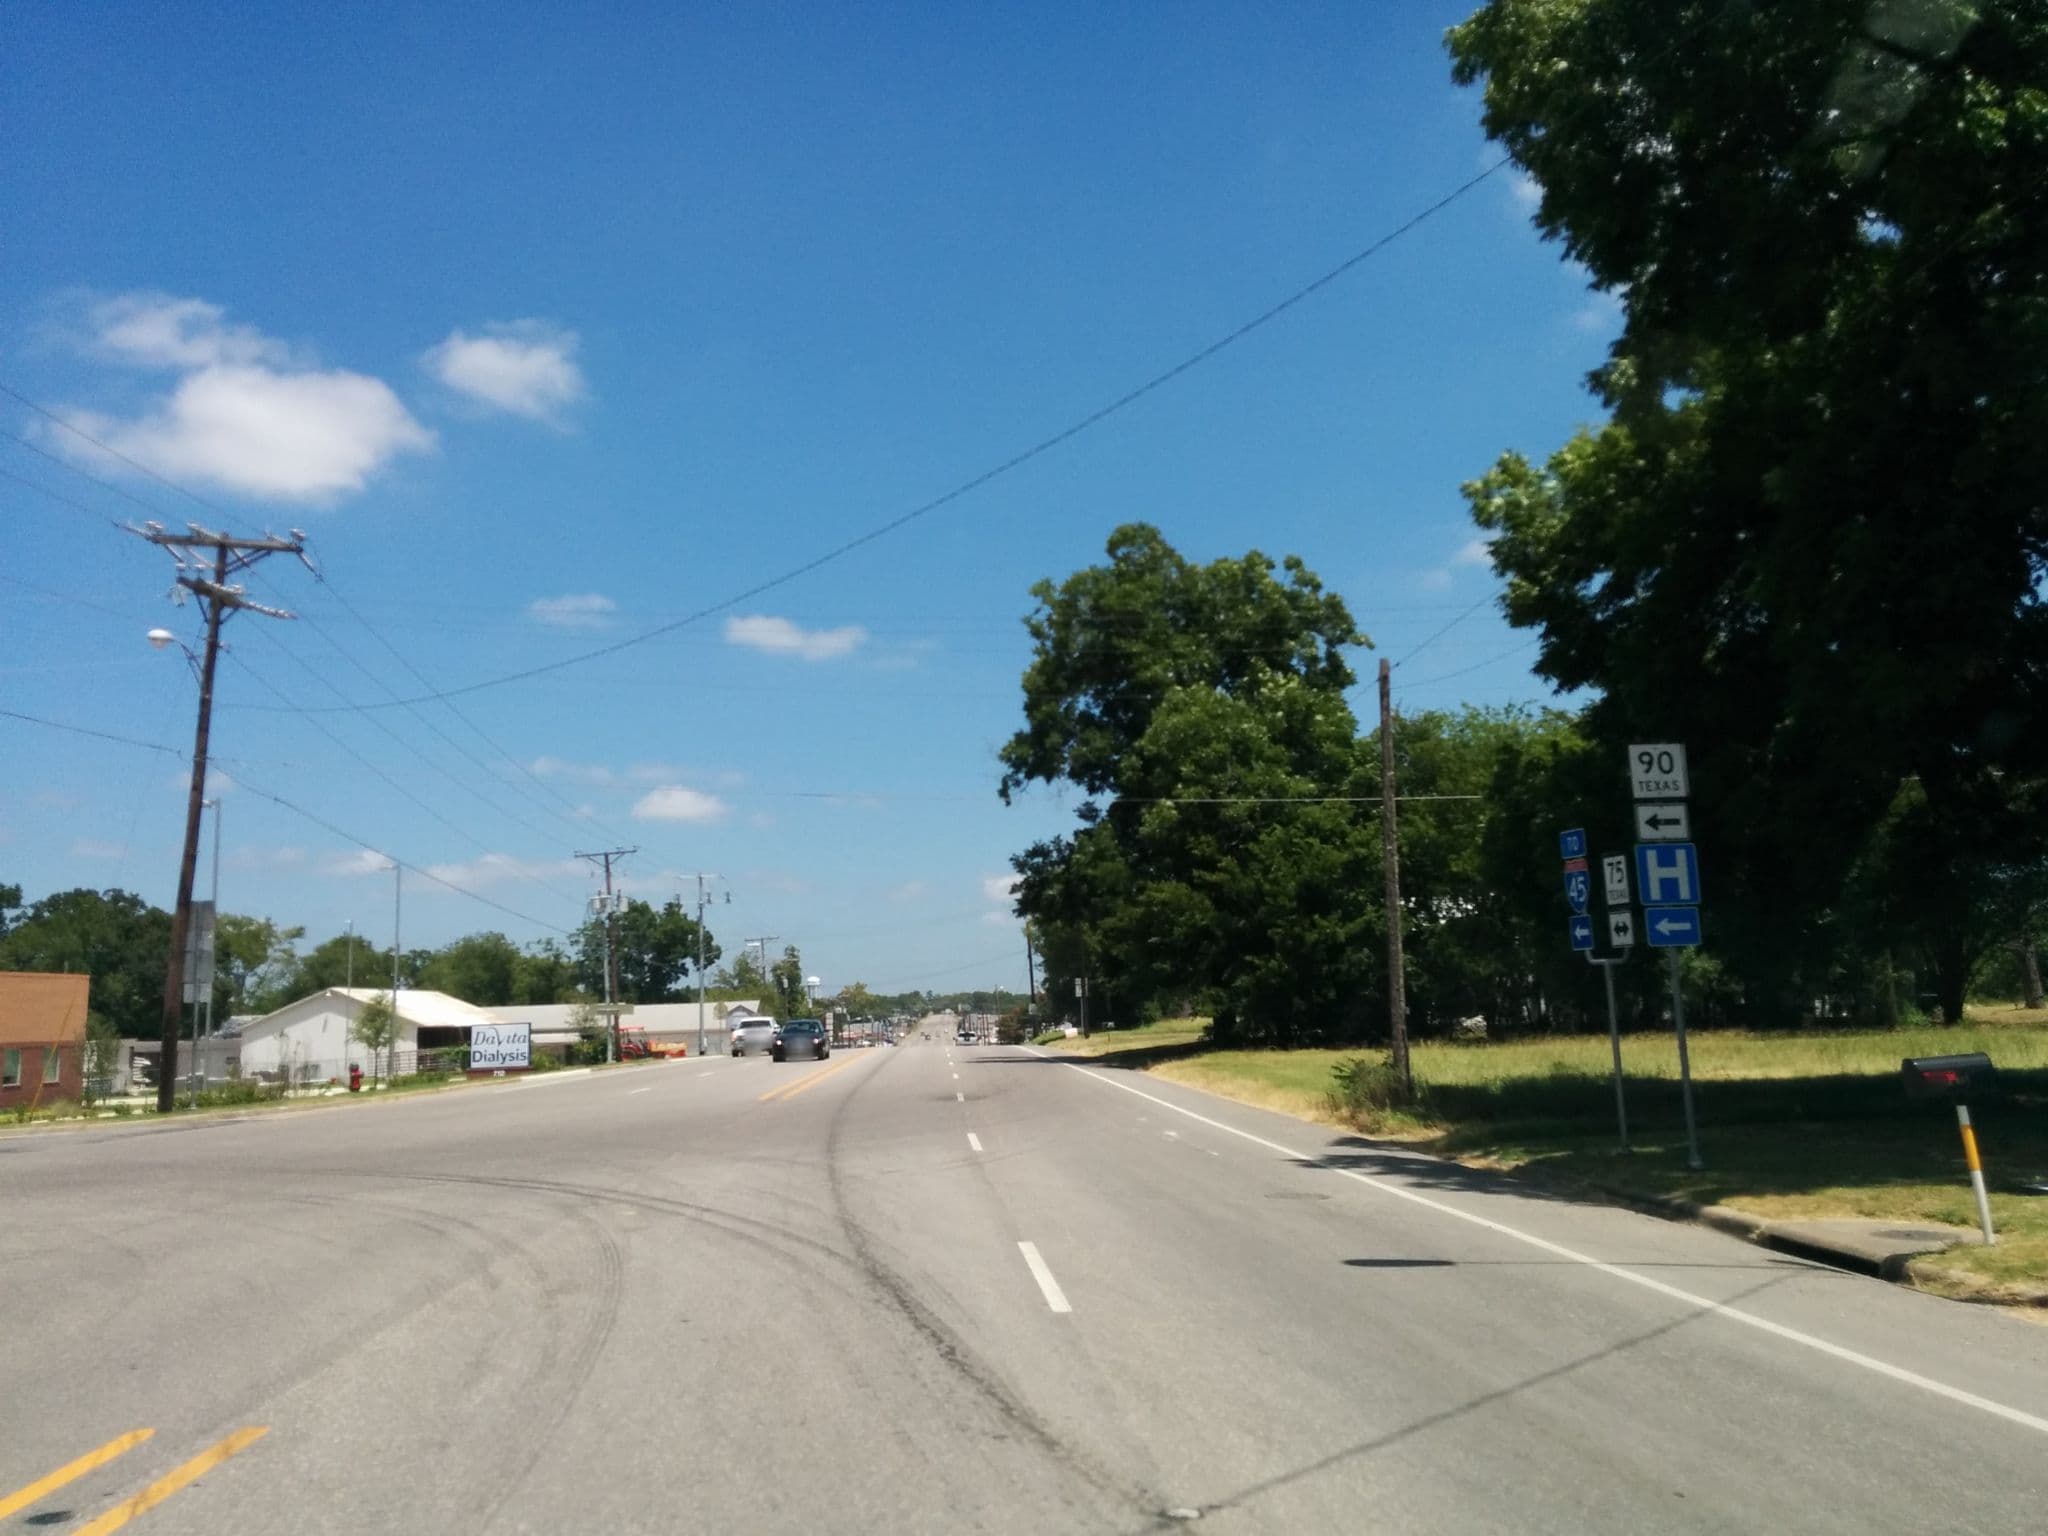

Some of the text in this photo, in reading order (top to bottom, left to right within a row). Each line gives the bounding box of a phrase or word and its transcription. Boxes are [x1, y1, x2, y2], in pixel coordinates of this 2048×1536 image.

[1638, 751, 1674, 774] 90
[1639, 780, 1680, 793] TEXAS
[1607, 861, 1624, 884] 75
[1646, 849, 1692, 901] H
[1569, 877, 1587, 902] 45
[472, 1049, 527, 1064] Dialysis
